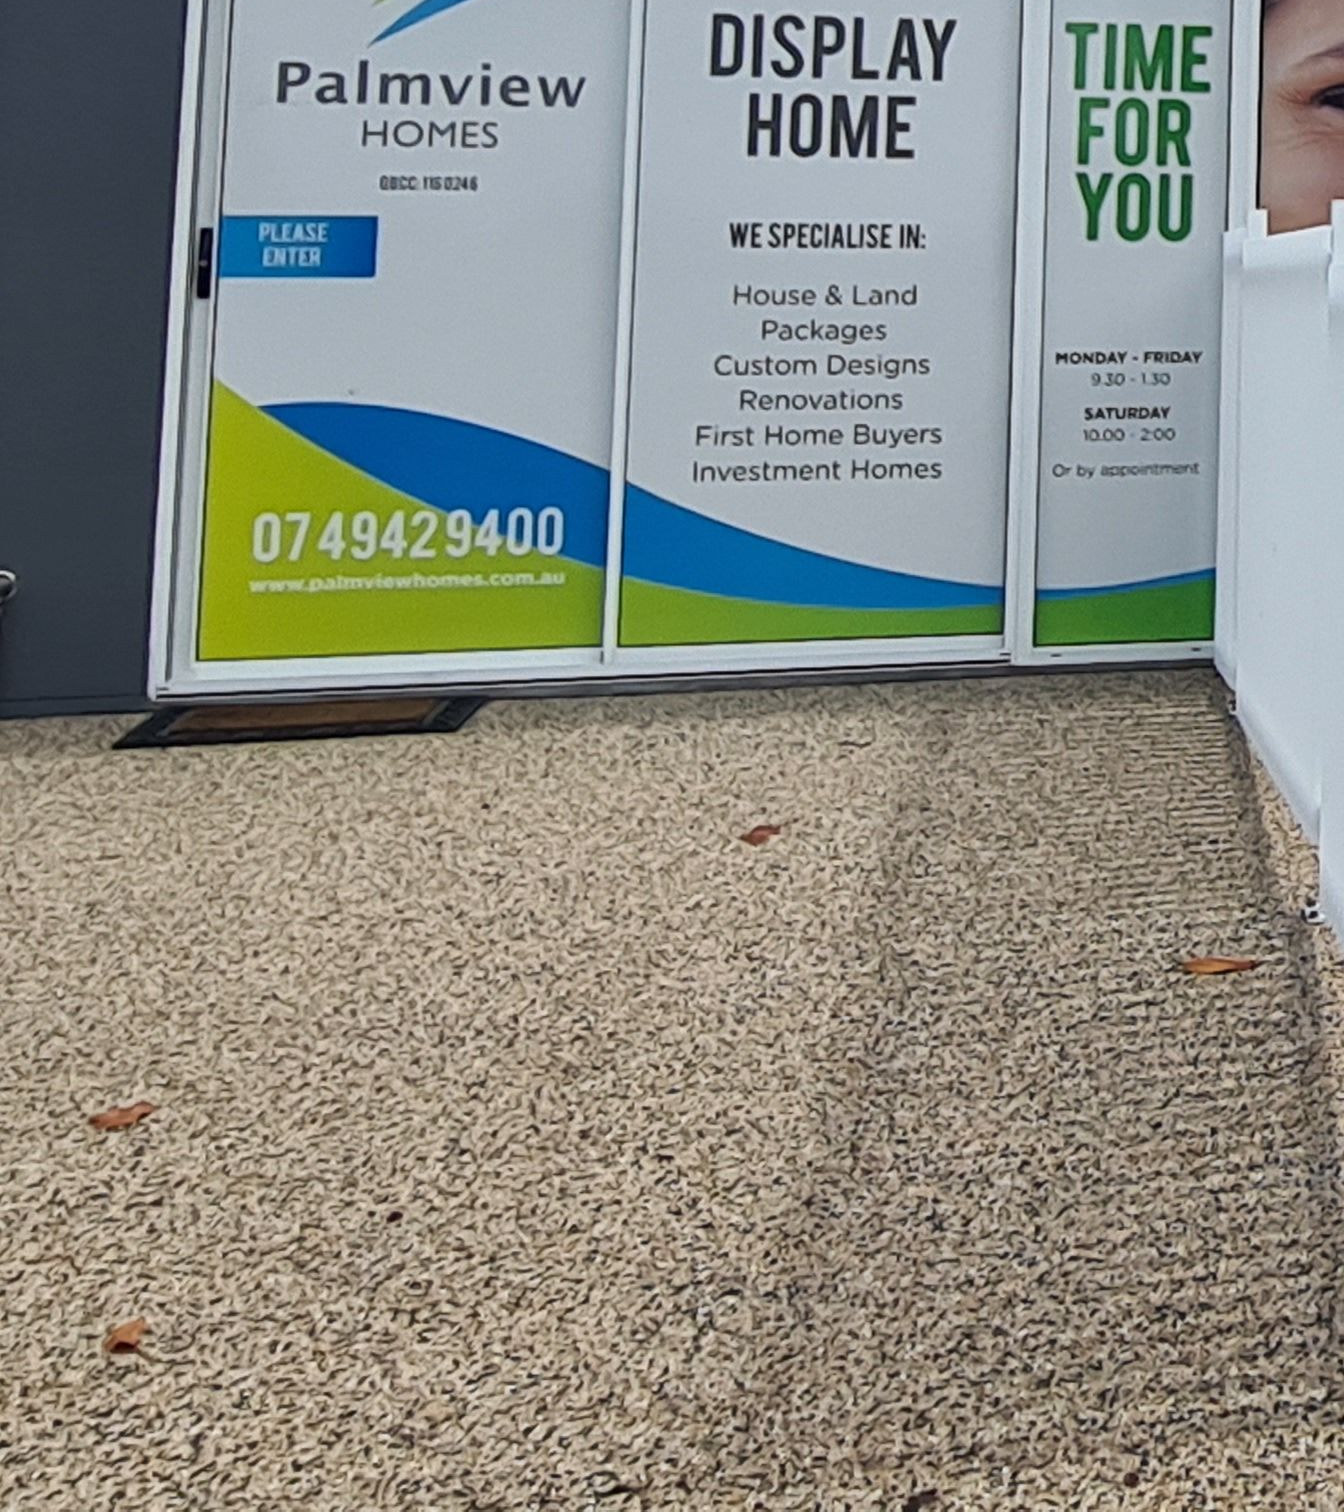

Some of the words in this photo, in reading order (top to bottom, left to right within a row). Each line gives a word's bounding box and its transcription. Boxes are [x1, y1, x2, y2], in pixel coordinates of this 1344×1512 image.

[709, 12, 957, 82] DISPLAY
[1064, 21, 1214, 94] TIME
[276, 59, 587, 108] Palmview
[361, 119, 499, 149] HOMES
[746, 92, 917, 160] HOME
[1076, 96, 1192, 168] FOR
[1075, 171, 1194, 243] YOU
[258, 221, 329, 243] PLEASE
[729, 222, 763, 249] WE
[767, 222, 893, 249] SPECIALISE
[899, 223, 926, 249] IN:
[262, 245, 321, 267] ENTER
[732, 284, 817, 307] House
[824, 283, 843, 306] &
[852, 284, 918, 306] Land
[761, 318, 888, 345] Packages
[713, 354, 818, 377] Custom
[826, 354, 931, 380] Designs
[1055, 351, 1128, 365] MONDAY
[1143, 350, 1203, 364] FRIDAY
[739, 389, 903, 412] Renovations
[1084, 406, 1171, 422] SATURDAY
[695, 425, 755, 447] First
[764, 424, 845, 447] Home
[853, 423, 943, 449] Buyers
[692, 460, 841, 483] Investment
[850, 459, 943, 480] Homes
[1051, 463, 1072, 478] Or
[1076, 464, 1095, 480] by
[1100, 462, 1201, 478] appointment
[249, 570, 566, 593] www.palmviewhomes.com.au
